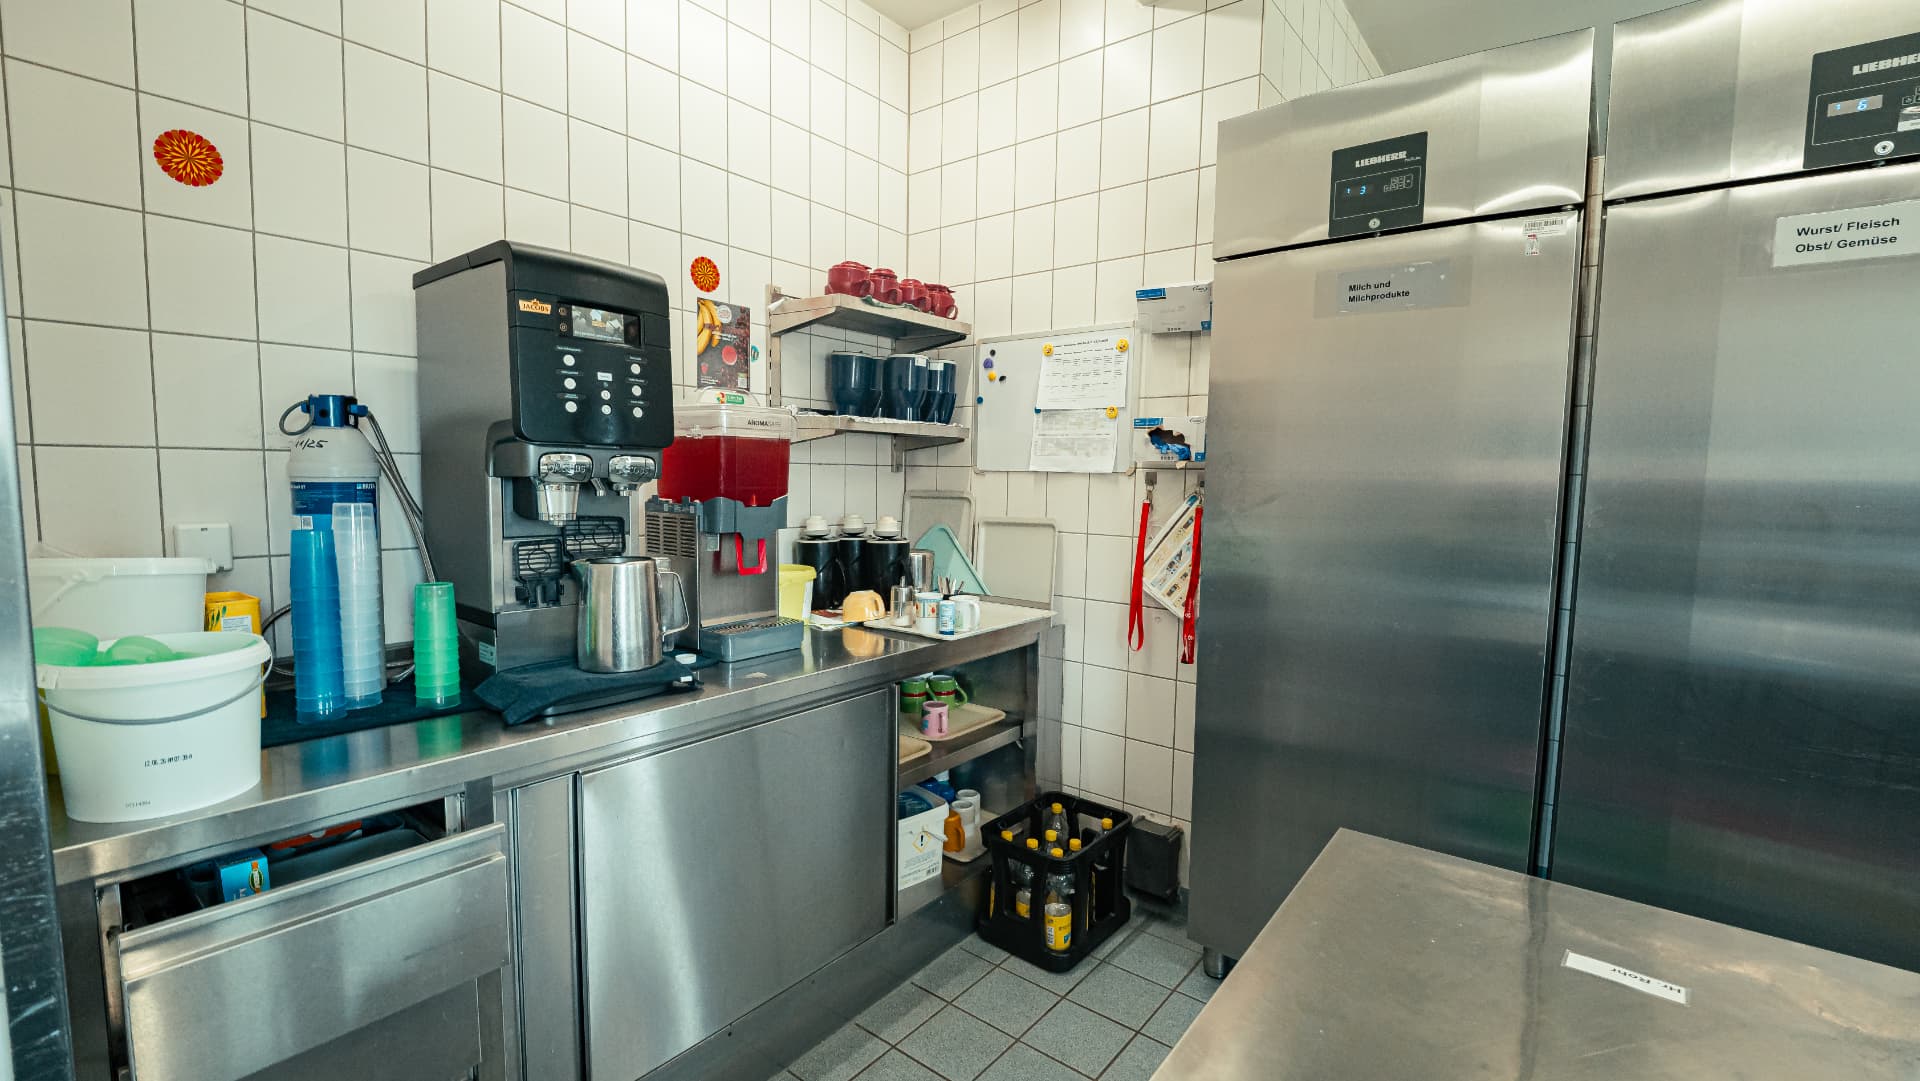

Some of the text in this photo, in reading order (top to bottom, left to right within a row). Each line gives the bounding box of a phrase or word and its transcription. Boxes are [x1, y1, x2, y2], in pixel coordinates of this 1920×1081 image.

[1852, 53, 1920, 75] LIEBHE
[1355, 150, 1407, 168] LIEBHERR
[1796, 217, 1900, 237] Wurst/ Fleisch
[1795, 235, 1898, 253] Obst/ Gemüse
[1348, 280, 1391, 292] Milch und
[1348, 290, 1410, 303] Milchprodukte
[523, 303, 549, 312] JACOBS
